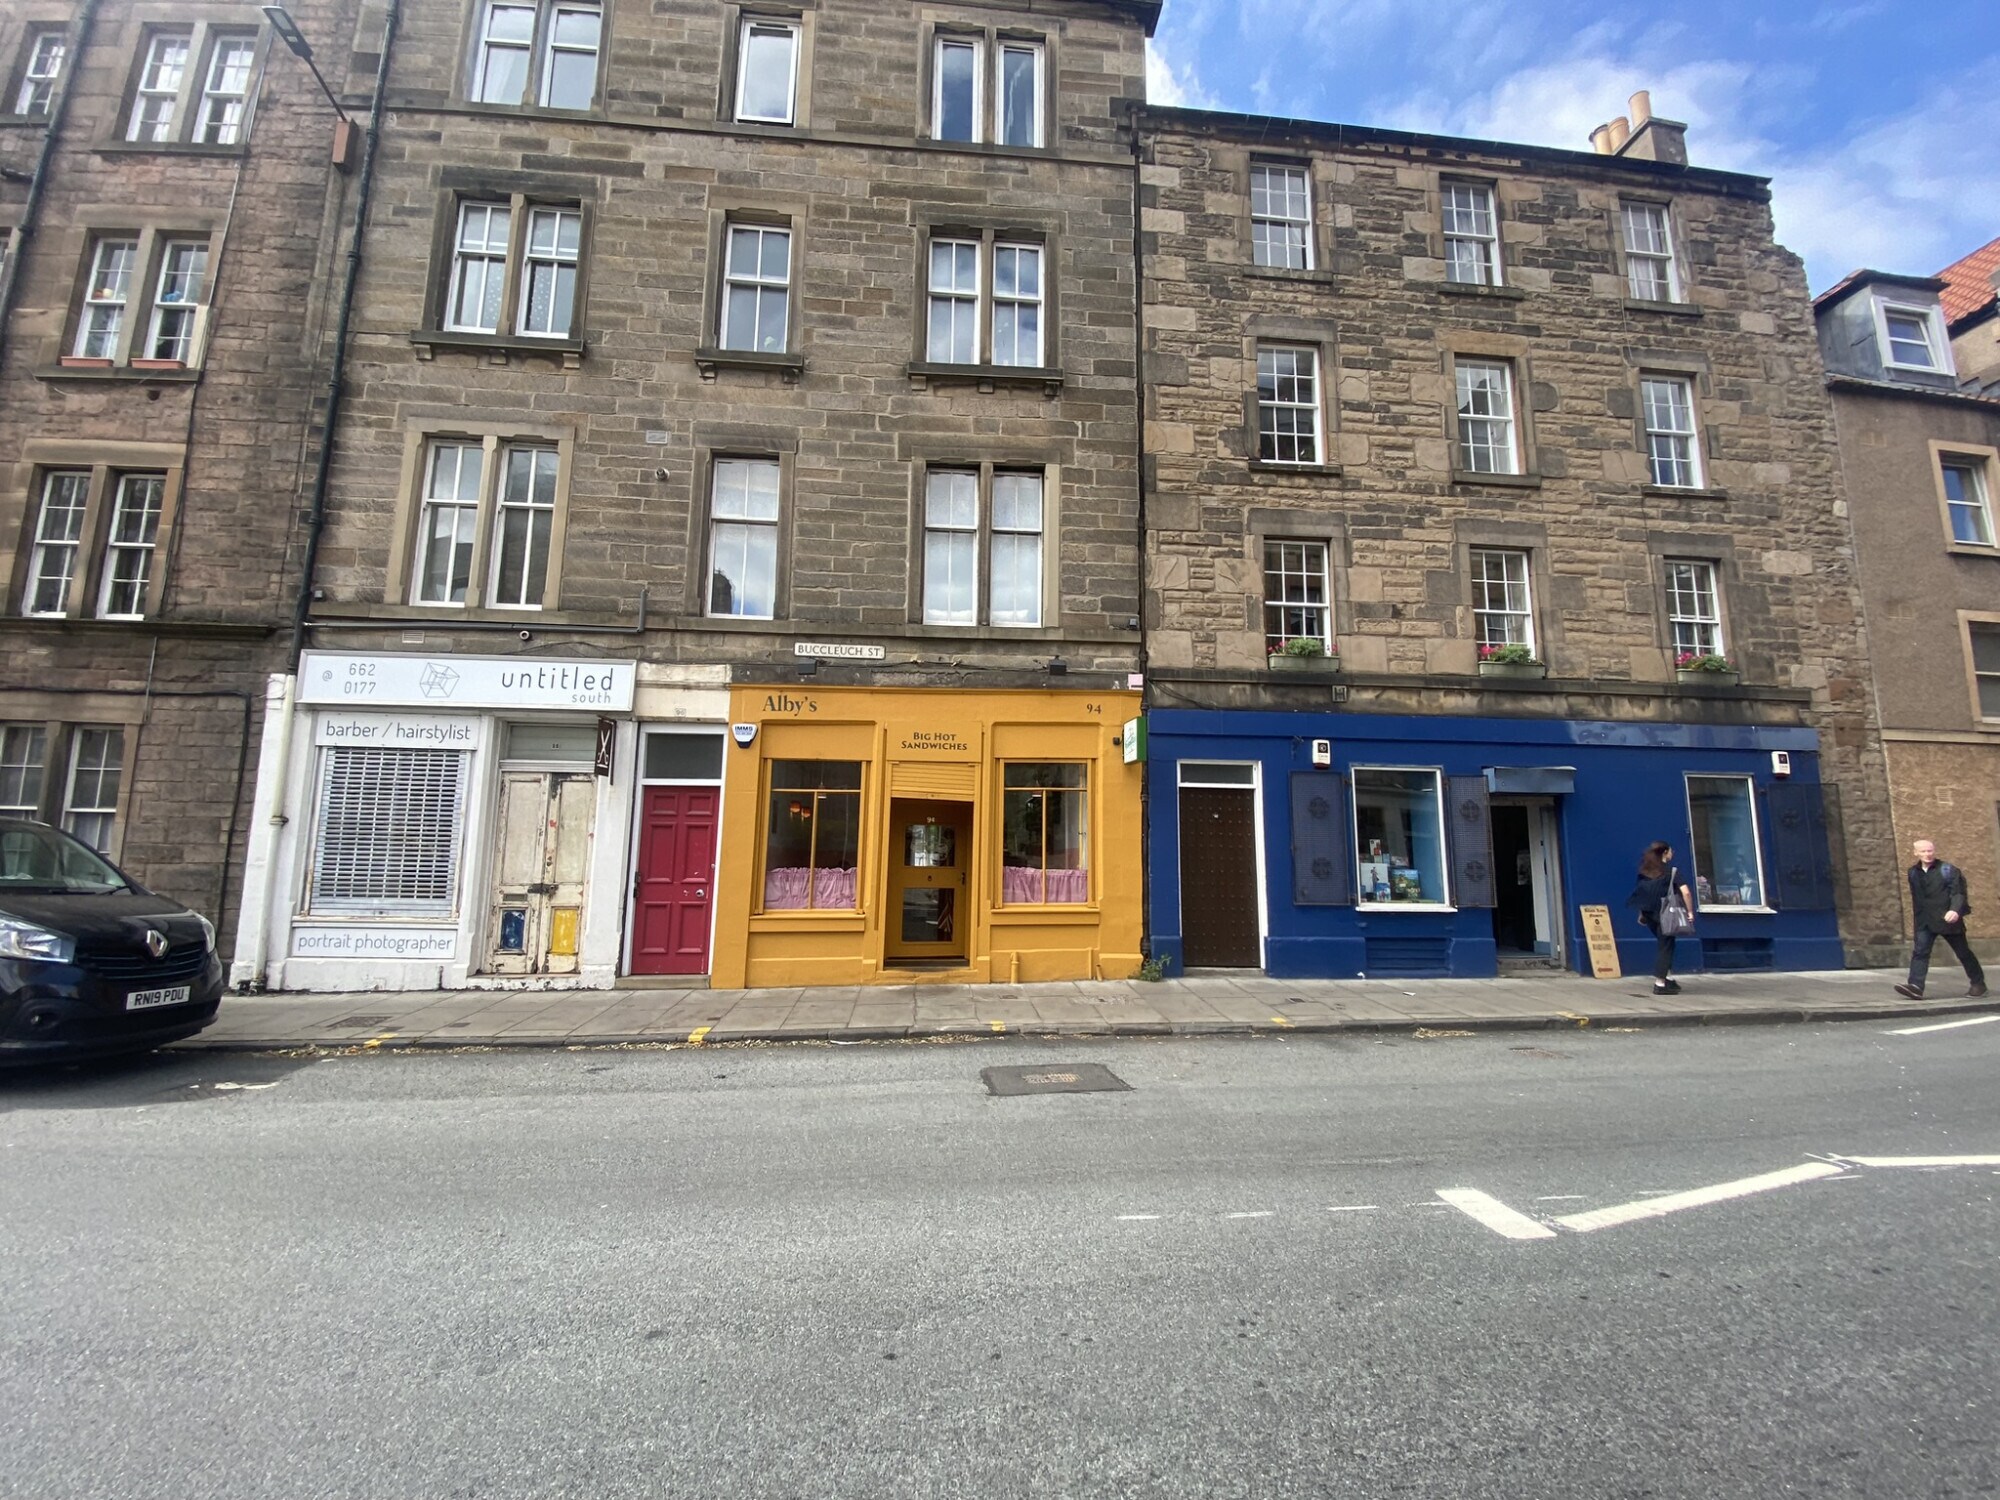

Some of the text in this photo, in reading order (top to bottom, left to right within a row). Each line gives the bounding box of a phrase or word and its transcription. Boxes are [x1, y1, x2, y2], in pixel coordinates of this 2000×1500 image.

[797, 645, 863, 656] BUCCLEUCH
[349, 663, 376, 676] 662
[501, 666, 613, 690] untitled
[344, 681, 376, 694] 0177
[571, 692, 611, 703] south
[762, 694, 818, 717] Alby's
[1086, 703, 1102, 714] 94
[326, 720, 378, 737] barber
[396, 722, 471, 744] hairstylist
[298, 933, 452, 954] portrait photographer
[134, 988, 185, 1006] RN19 PDU
